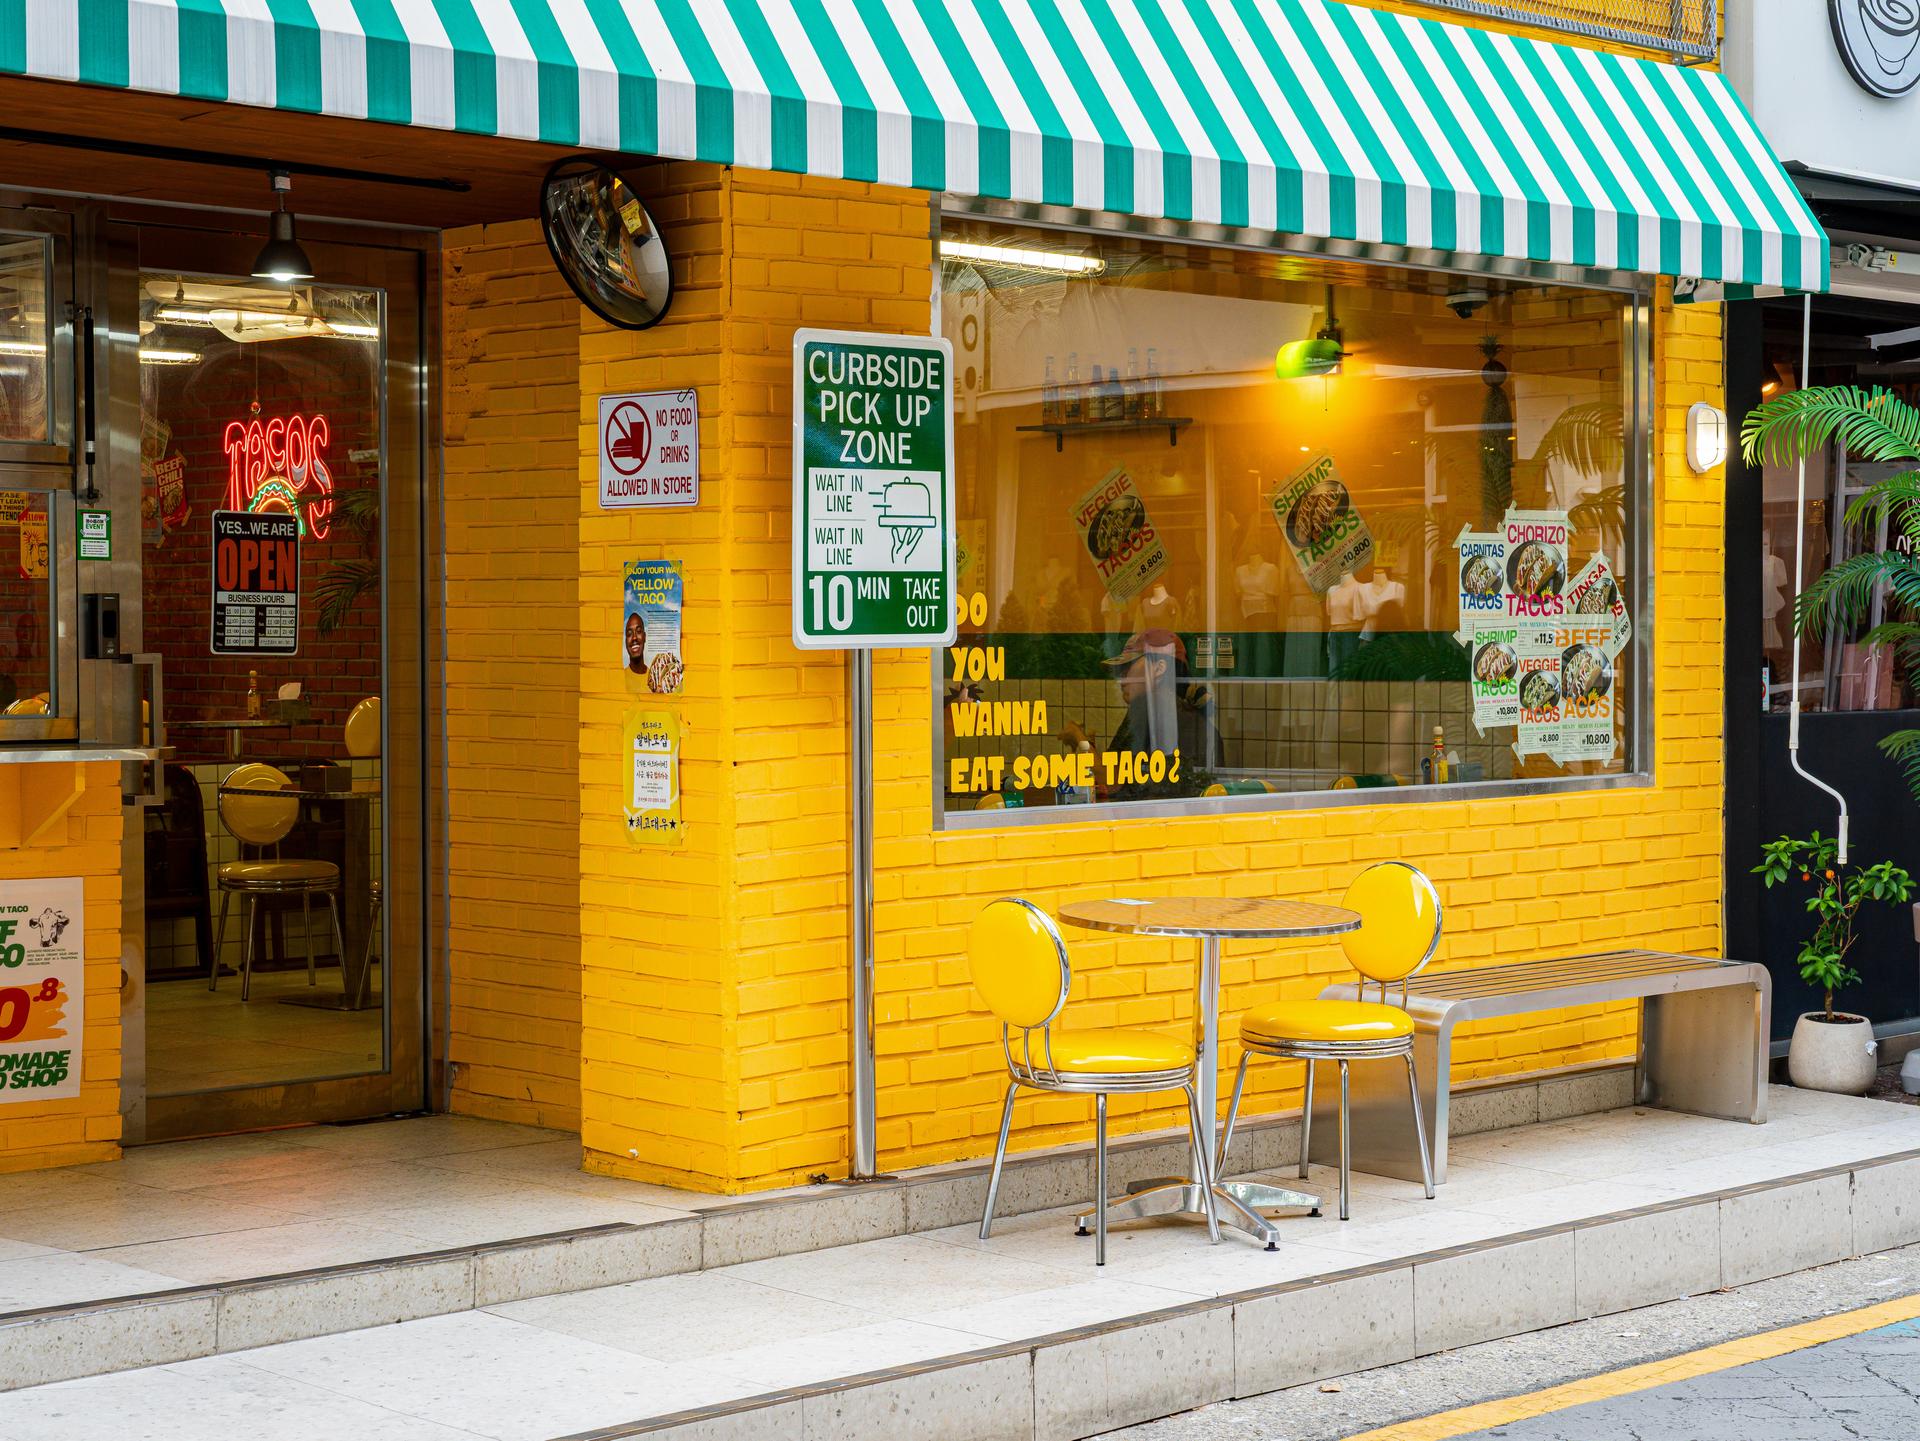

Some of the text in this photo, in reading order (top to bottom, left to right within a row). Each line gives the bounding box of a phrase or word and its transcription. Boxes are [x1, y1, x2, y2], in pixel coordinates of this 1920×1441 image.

[809, 350, 940, 390] CURBSIDE
[656, 408, 692, 427] NO FOOD
[820, 390, 931, 427] PICK UP
[671, 429, 679, 442] OR
[660, 445, 690, 464] DRINKS
[840, 430, 912, 465] ZONE
[155, 456, 183, 475] BEEF
[158, 467, 183, 486] CHILI
[224, 415, 334, 539] TACOS
[607, 476, 692, 497] ALLOWED IN STORE
[815, 474, 863, 492] WAIT IN
[1274, 458, 1332, 516] SHRIMP
[826, 495, 853, 512] LINE
[1076, 473, 1131, 528] VEGGIE
[271, 523, 295, 537] ARE
[815, 527, 863, 545] WAIT IN
[1296, 510, 1360, 567] TACOS
[1507, 524, 1566, 545] CHORIZO
[826, 548, 853, 565] LINE
[1097, 522, 1155, 578] TACOS
[1461, 543, 1505, 558] CARNITAS
[217, 538, 296, 592] OPEN
[626, 566, 680, 575] ENJOY YOUR WAY
[631, 578, 675, 591] YELLOW
[903, 578, 941, 600] TAKE
[1567, 562, 1607, 605] TINGA
[228, 594, 285, 604] BUSINESS HOURS
[638, 592, 666, 605] TACO
[809, 575, 890, 631] 10 MIN
[1461, 593, 1503, 610] TACOS
[1506, 593, 1564, 617] TACOS
[906, 605, 938, 627] OUT
[956, 591, 988, 627] DO
[1475, 630, 1518, 646] SHRIMP
[1555, 628, 1611, 648] BEEF
[950, 646, 1005, 682] YOU
[1519, 658, 1561, 673] VEGGIE
[1473, 679, 1518, 697] TACOS
[1519, 706, 1561, 724] TACOS
[1562, 696, 1610, 719] ACOS
[951, 700, 1048, 737] WANNA
[951, 756, 1005, 793] EAT
[1013, 752, 1095, 790] SOME
[6, 905, 29, 913] TACO
[9, 1067, 68, 1090] SHOP
